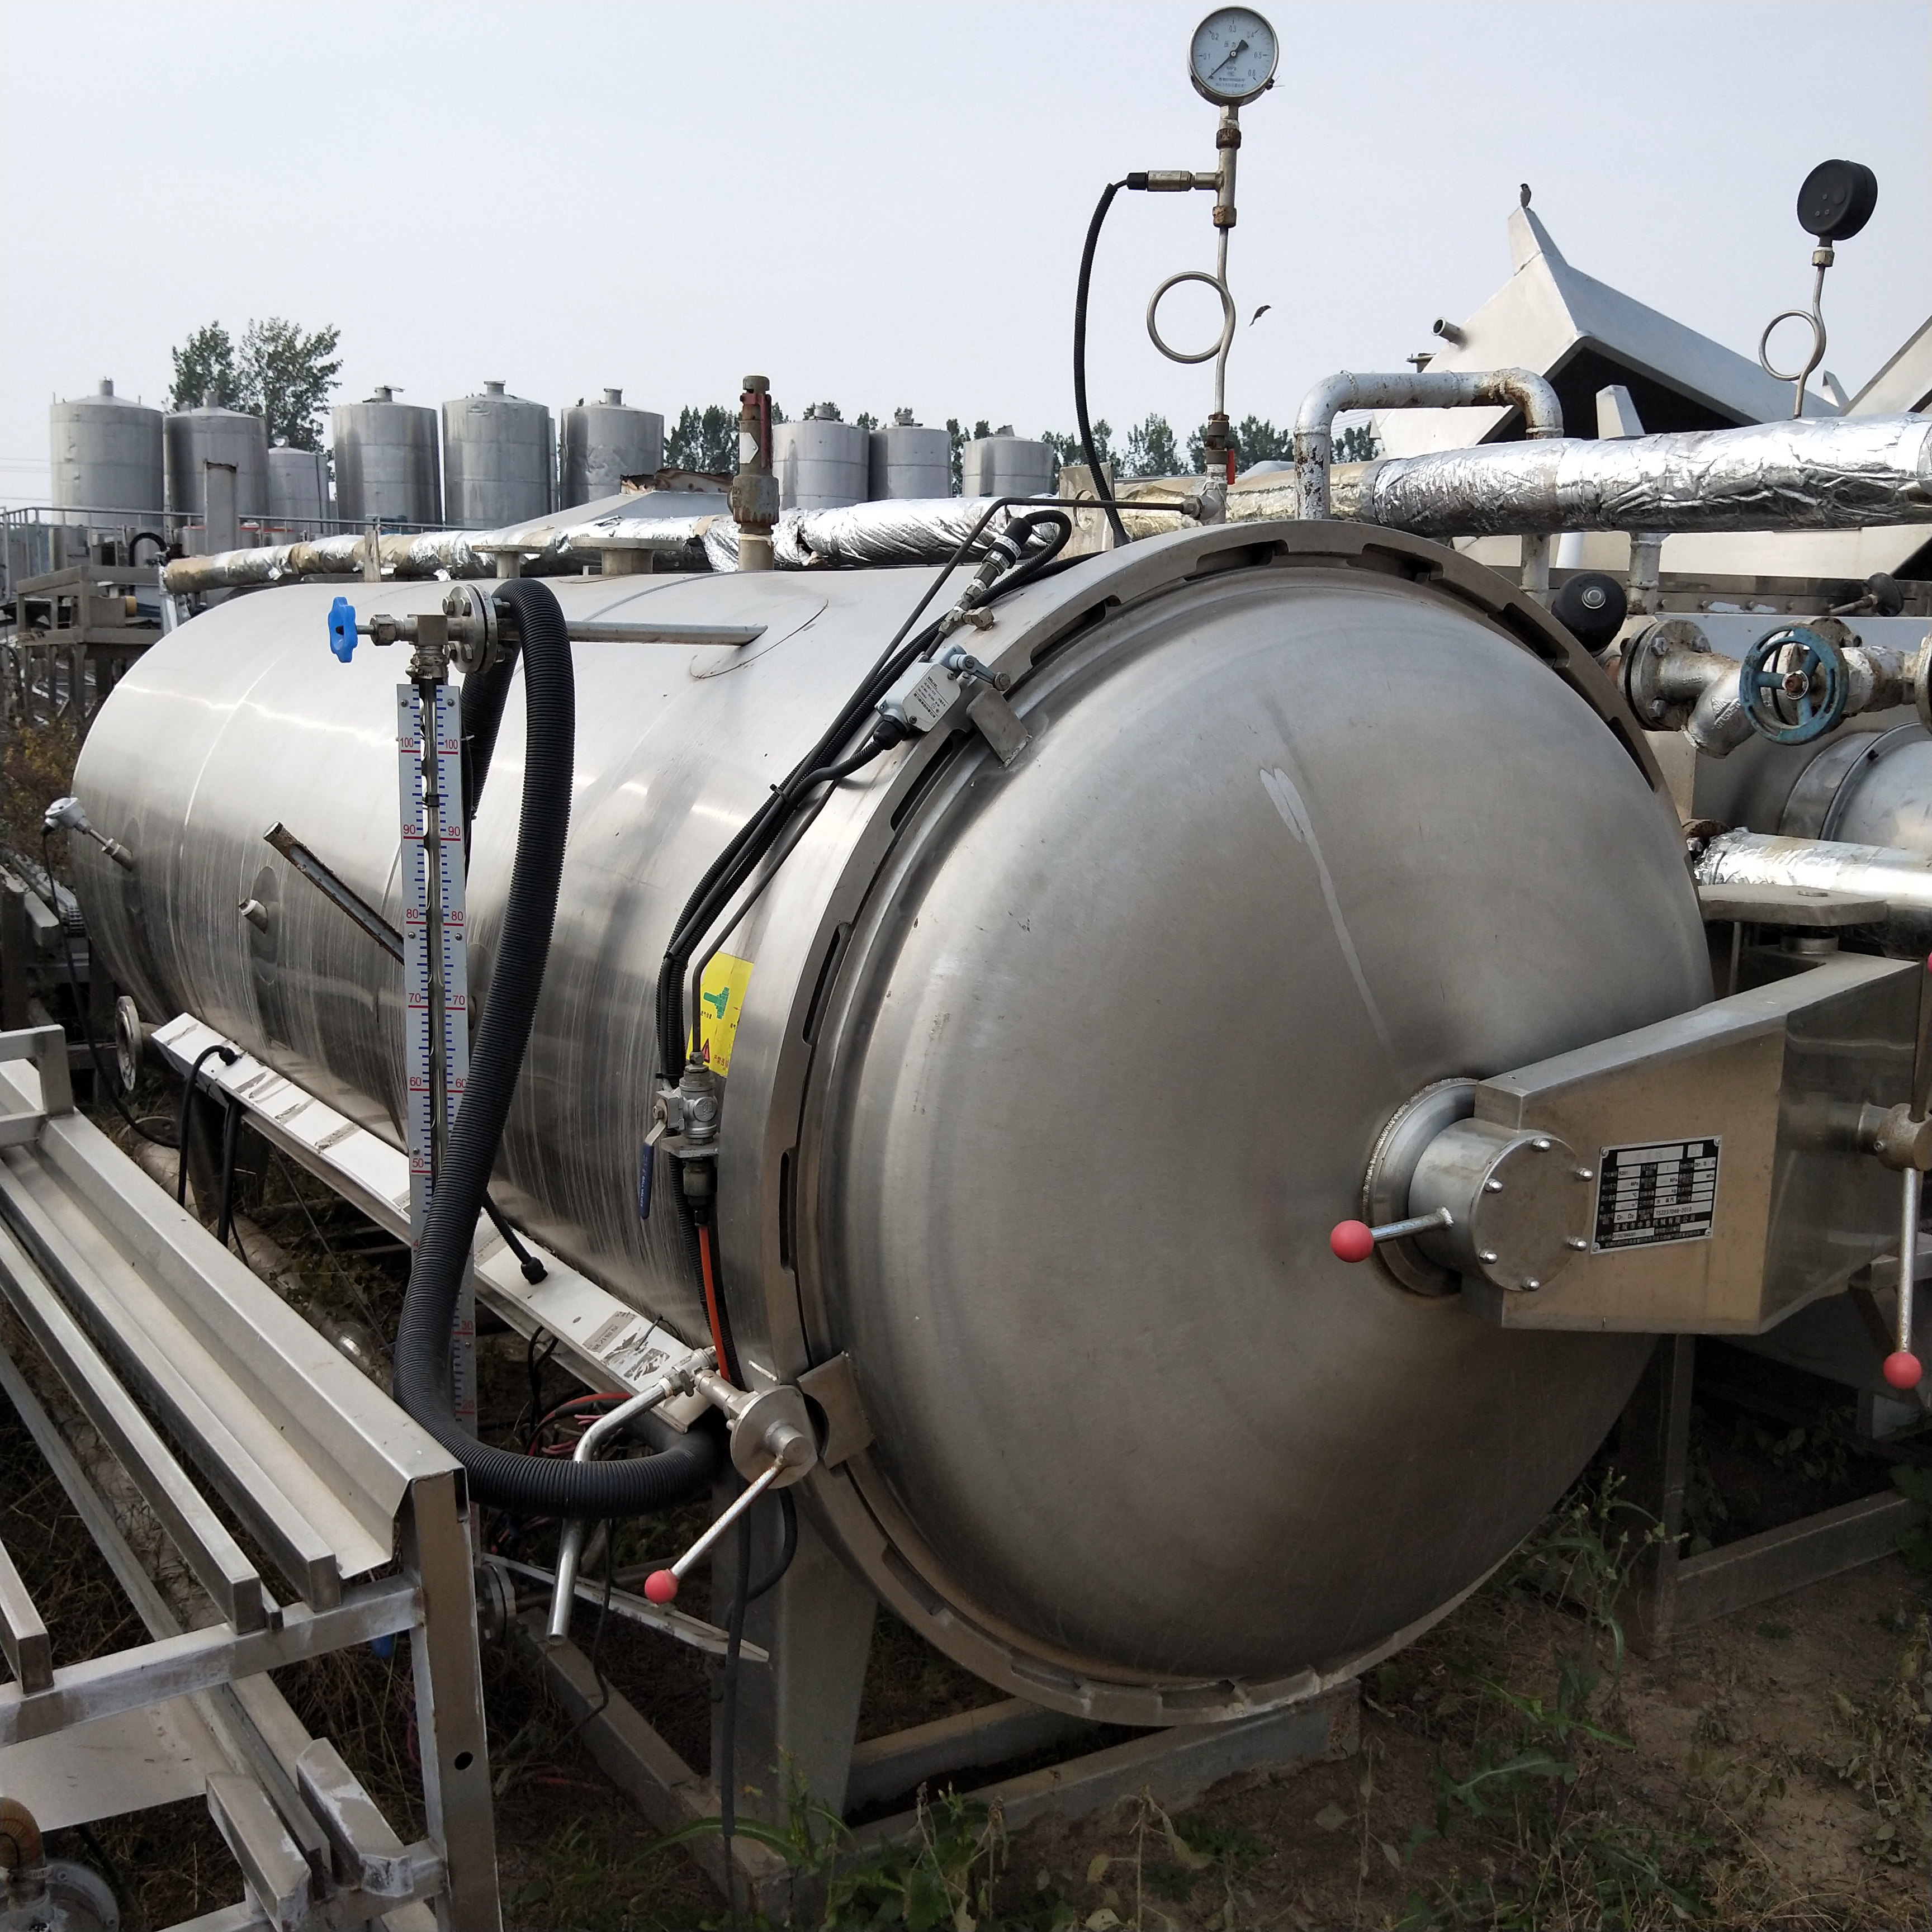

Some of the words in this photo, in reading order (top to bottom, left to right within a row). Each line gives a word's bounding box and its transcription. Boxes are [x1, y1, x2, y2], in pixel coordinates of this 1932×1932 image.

[400, 737, 414, 747] 100
[444, 739, 458, 750] 100
[403, 825, 416, 835] 90
[448, 826, 461, 836] 90
[406, 909, 419, 919] 80
[451, 911, 463, 921] 80
[408, 993, 422, 1003] 70
[453, 995, 465, 1005] 70
[410, 1077, 422, 1087] 60
[456, 1078, 466, 1088] 60
[412, 1158, 424, 1168] 50
[461, 1320, 473, 1330] 30
